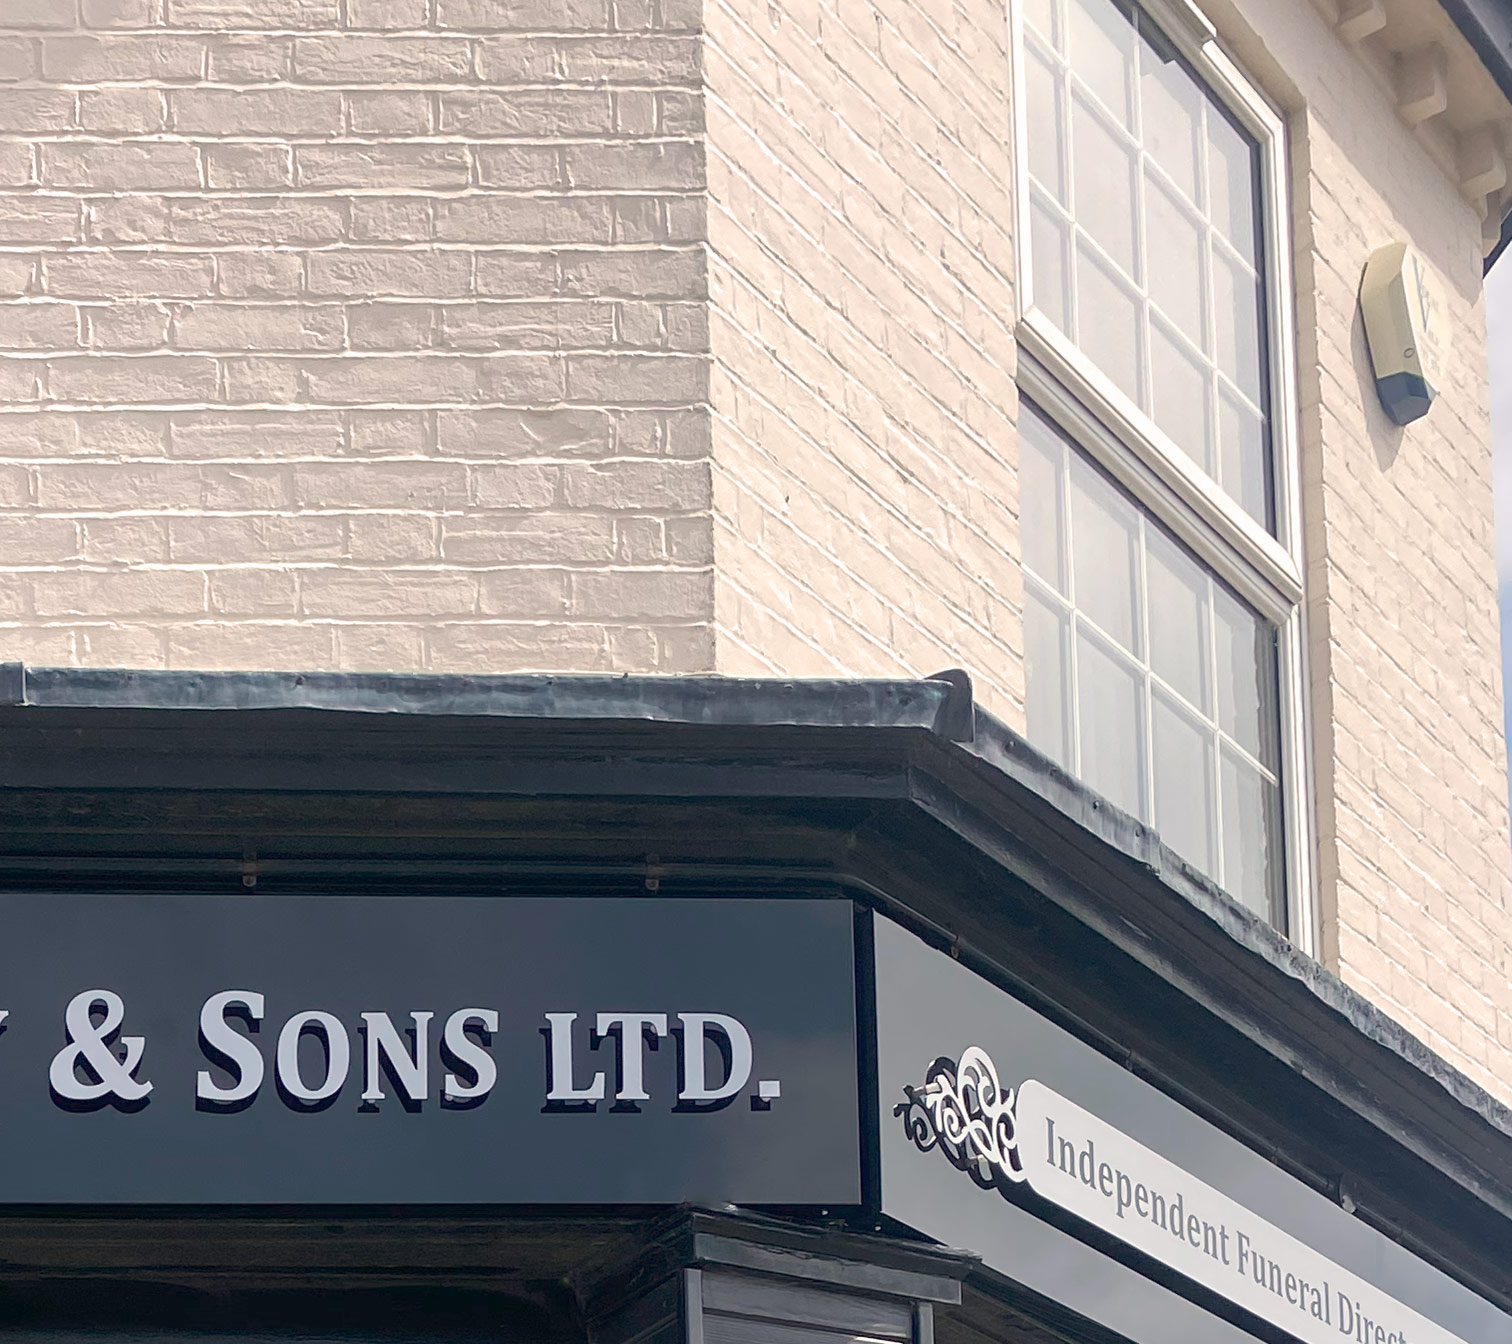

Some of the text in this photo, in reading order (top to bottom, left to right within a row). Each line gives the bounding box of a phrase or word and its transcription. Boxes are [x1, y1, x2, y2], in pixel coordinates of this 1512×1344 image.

[49, 988, 155, 1102] &
[196, 989, 500, 1102] SONS
[543, 1011, 781, 1101] LTD.
[1045, 1116, 1230, 1266] Independent
[1236, 1230, 1332, 1327] Funeral
